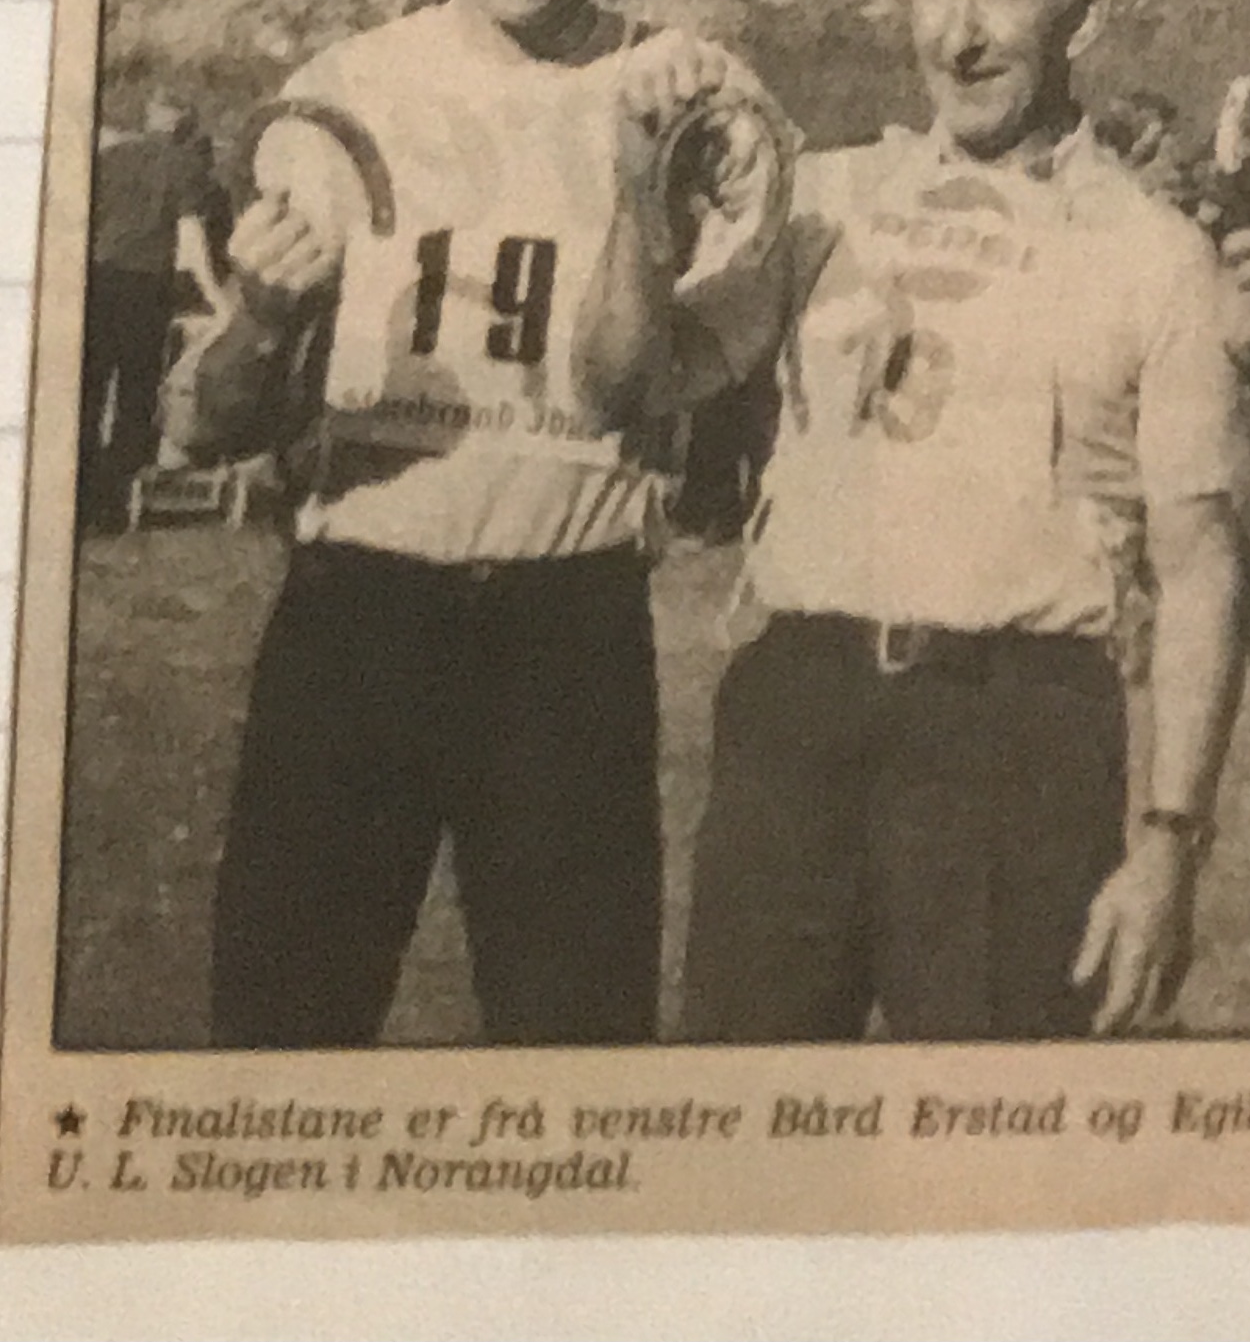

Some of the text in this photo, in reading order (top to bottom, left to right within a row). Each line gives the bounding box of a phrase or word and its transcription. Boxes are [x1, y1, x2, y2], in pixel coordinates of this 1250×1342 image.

[410, 227, 557, 364] 19
[117, 1098, 383, 1139] Finalistane
[405, 1109, 457, 1138] er
[468, 1097, 545, 1148] frå
[572, 1099, 742, 1139] venstre
[768, 1095, 884, 1138] Bård
[909, 1094, 1067, 1138] Erstad
[1087, 1100, 1145, 1143] og
[170, 1151, 330, 1200] Slogen
[344, 1154, 360, 1191] i
